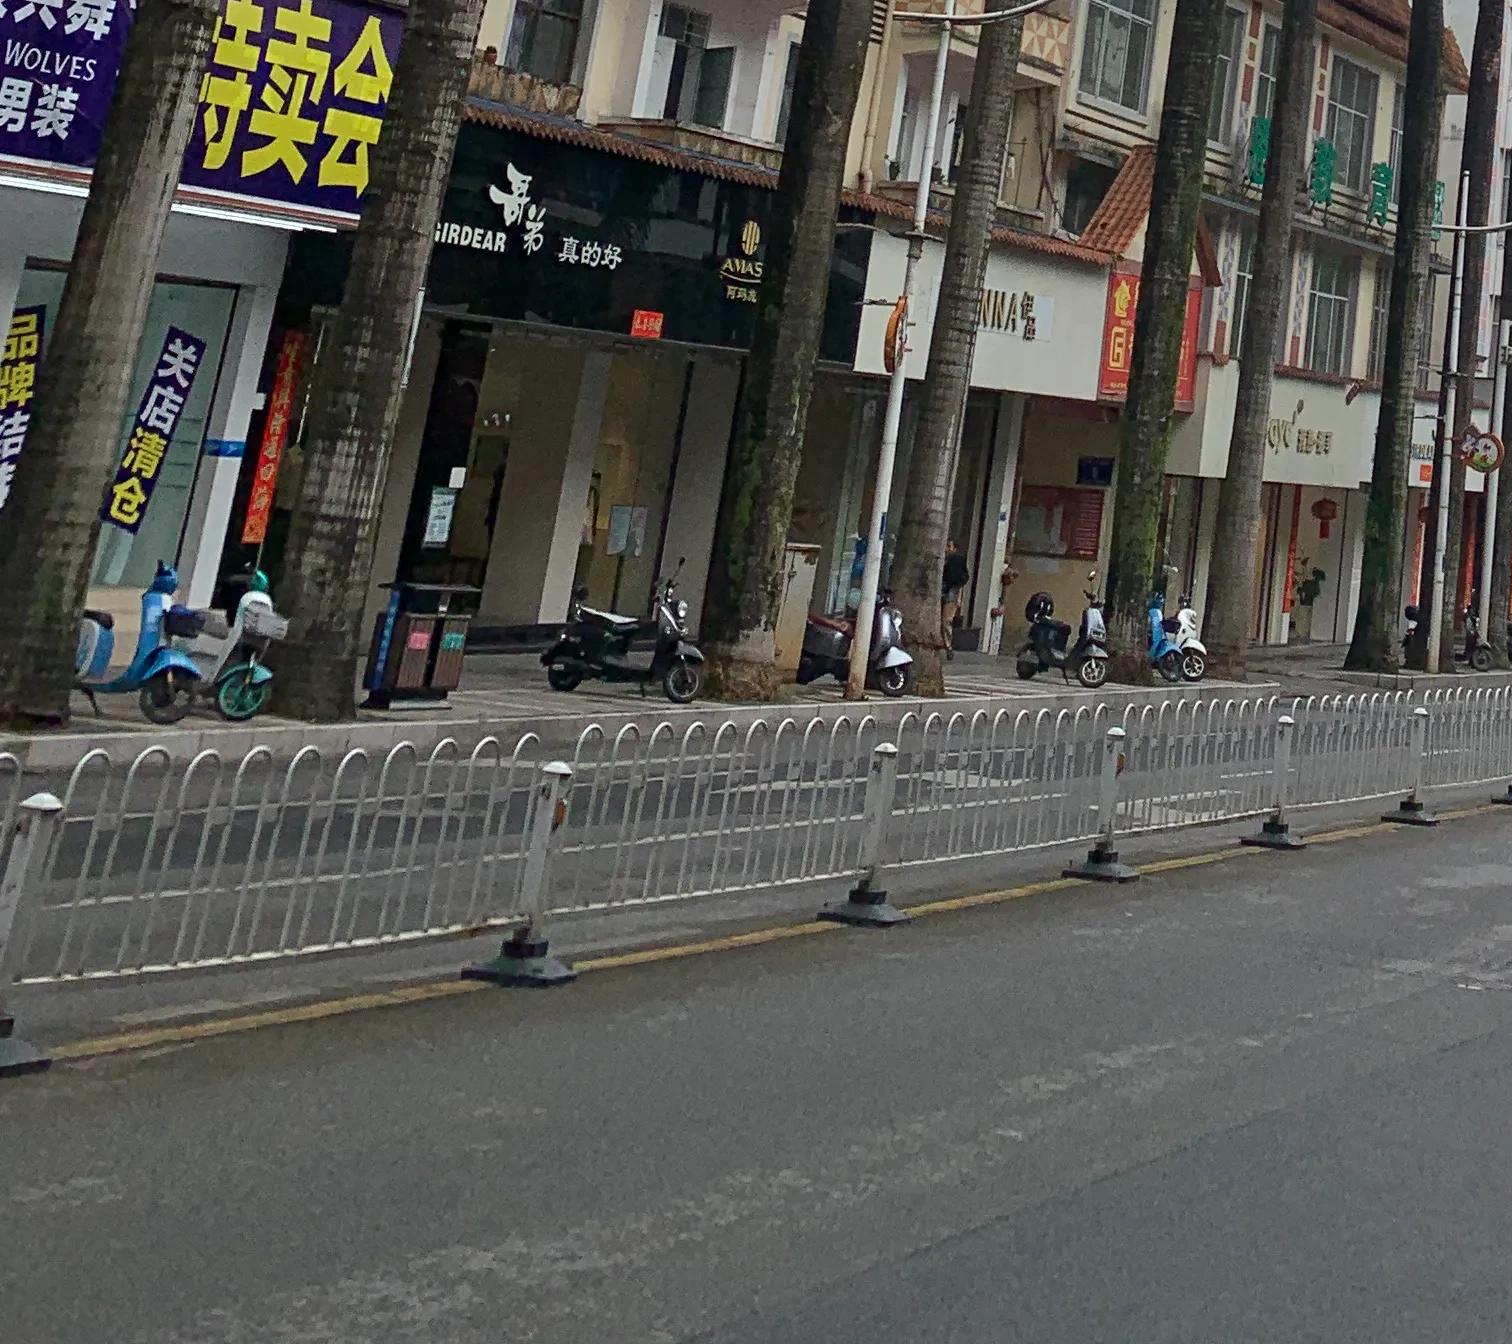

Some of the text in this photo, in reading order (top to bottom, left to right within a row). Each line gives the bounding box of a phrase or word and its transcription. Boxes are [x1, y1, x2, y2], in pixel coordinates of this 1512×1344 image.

[4, 38, 97, 82] WOLVES
[0, 76, 80, 140] 男装
[558, 235, 623, 271] 真的好
[109, 338, 197, 526] 关店清仓
